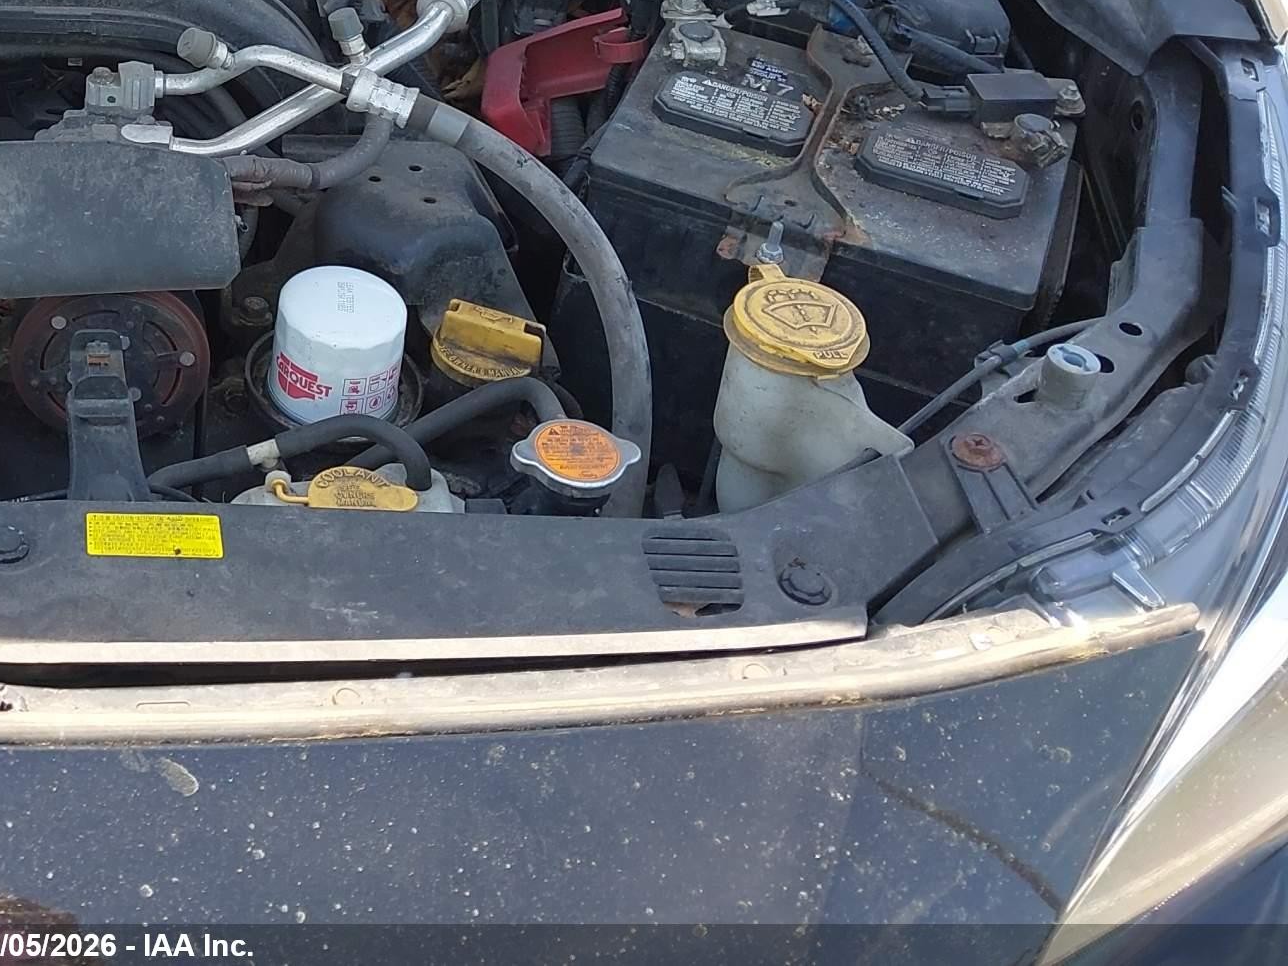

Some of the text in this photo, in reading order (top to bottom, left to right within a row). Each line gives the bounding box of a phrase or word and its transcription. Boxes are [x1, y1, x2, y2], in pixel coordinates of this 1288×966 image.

[813, 351, 848, 359] PULL
[276, 355, 333, 397] CARQUEST
[488, 365, 524, 379] MANUAL
[315, 468, 391, 489] COOLANT
